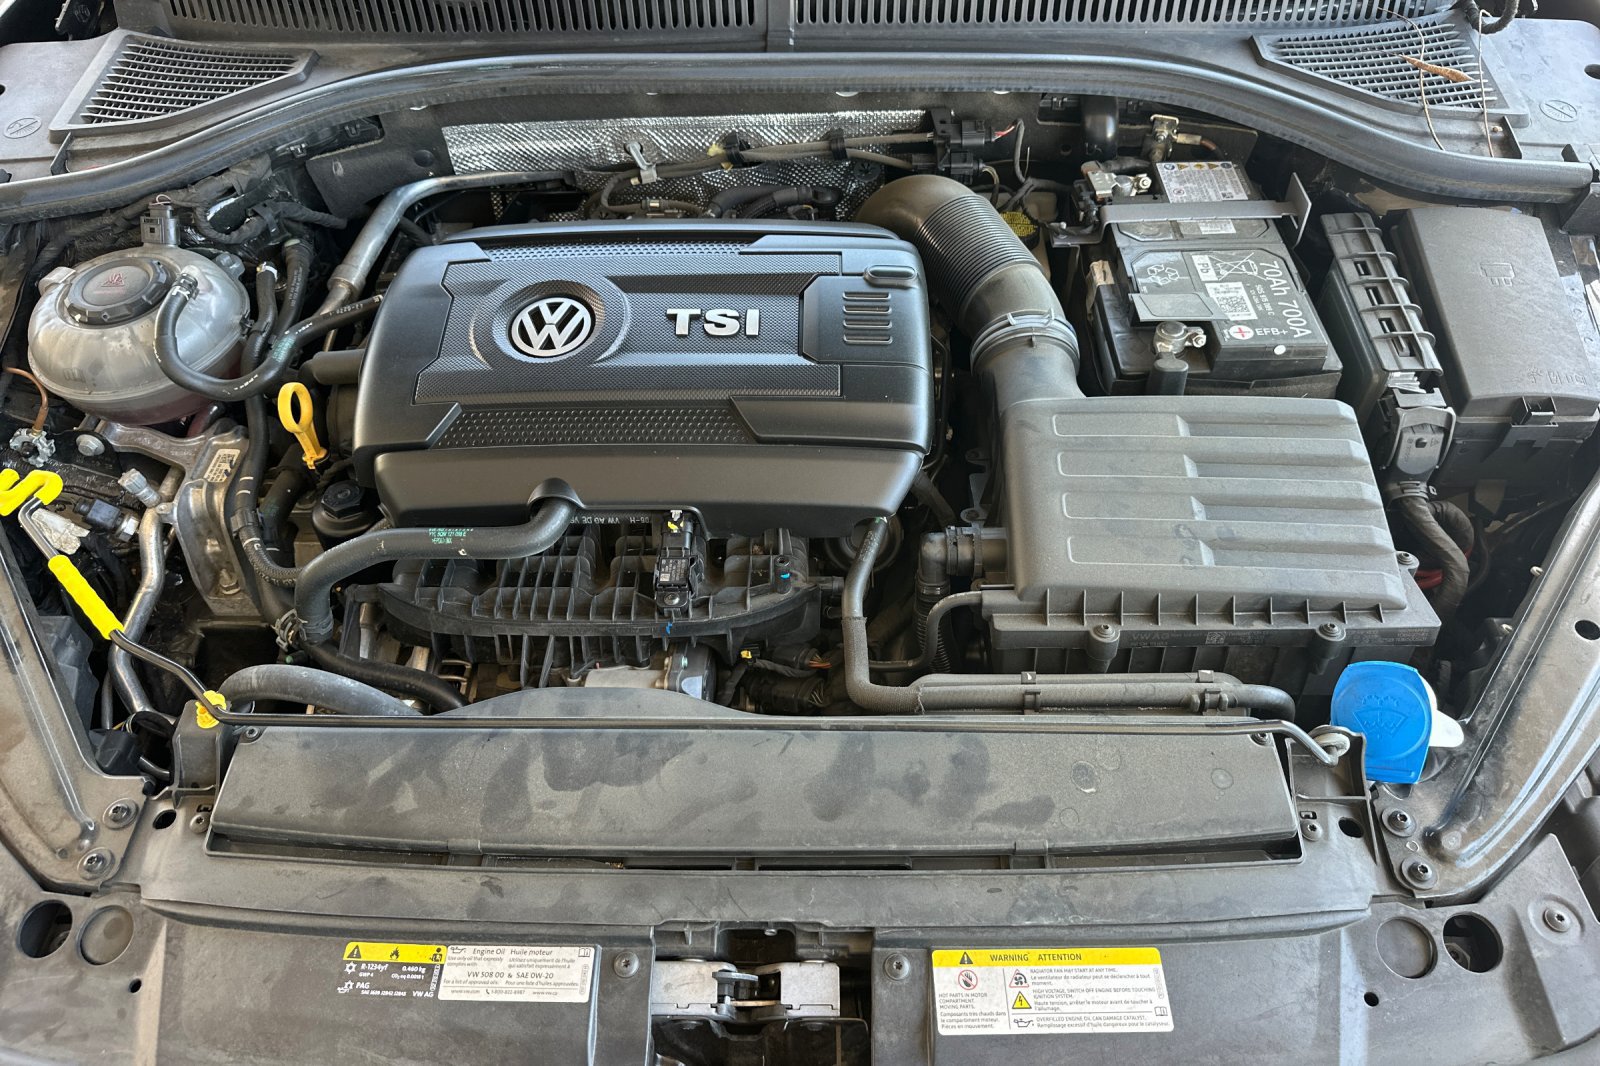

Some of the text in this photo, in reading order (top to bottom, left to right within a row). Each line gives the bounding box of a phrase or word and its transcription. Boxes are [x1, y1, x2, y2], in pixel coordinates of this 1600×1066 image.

[1198, 262, 1211, 274] Pb
[1259, 261, 1312, 338] 70Ah 700A
[666, 308, 760, 335] TSI
[1256, 327, 1288, 337] EFB+
[473, 948, 495, 956] Engine
[1038, 953, 1082, 961] ATTENTION
